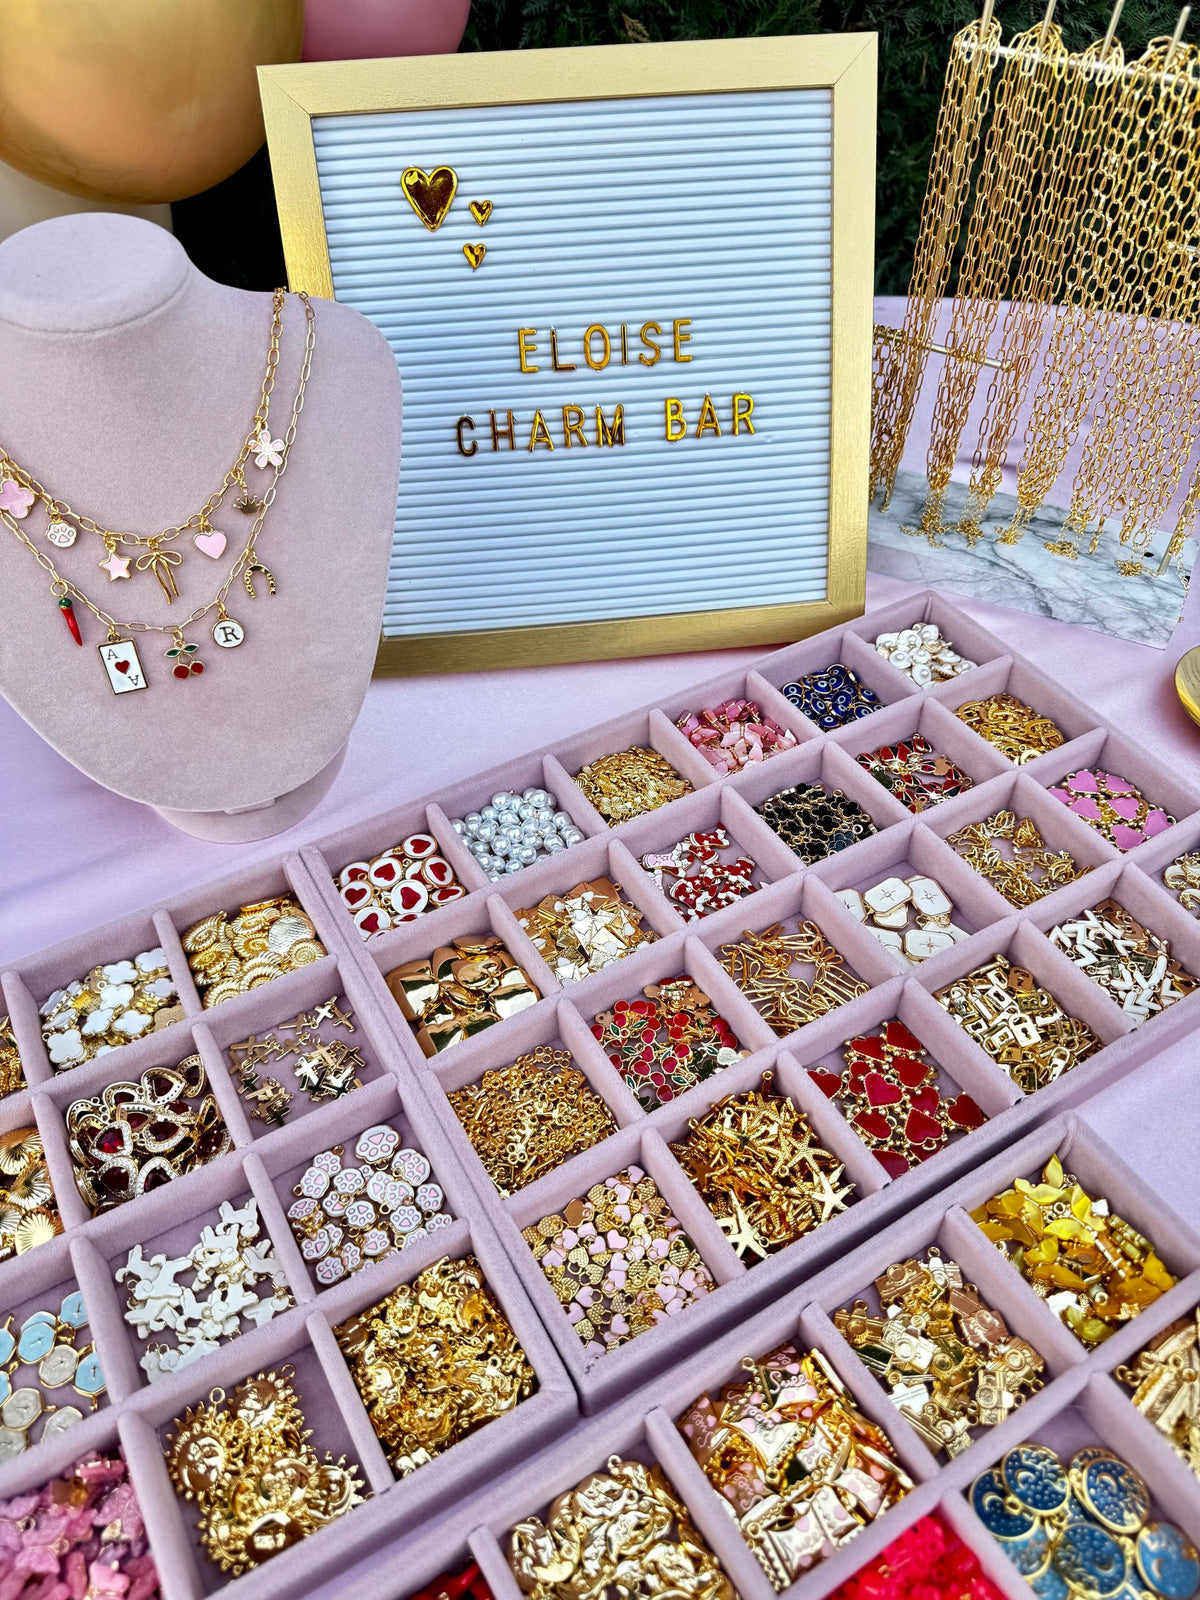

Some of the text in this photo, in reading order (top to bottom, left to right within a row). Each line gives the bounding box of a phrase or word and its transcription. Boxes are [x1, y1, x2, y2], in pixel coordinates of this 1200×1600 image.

[518, 319, 693, 373] ELOISE
[456, 393, 755, 457] CHARM BAR
[219, 626, 240, 643] R
[107, 648, 119, 660] A
[127, 674, 139, 686] A
[769, 1371, 811, 1395] Sweet
